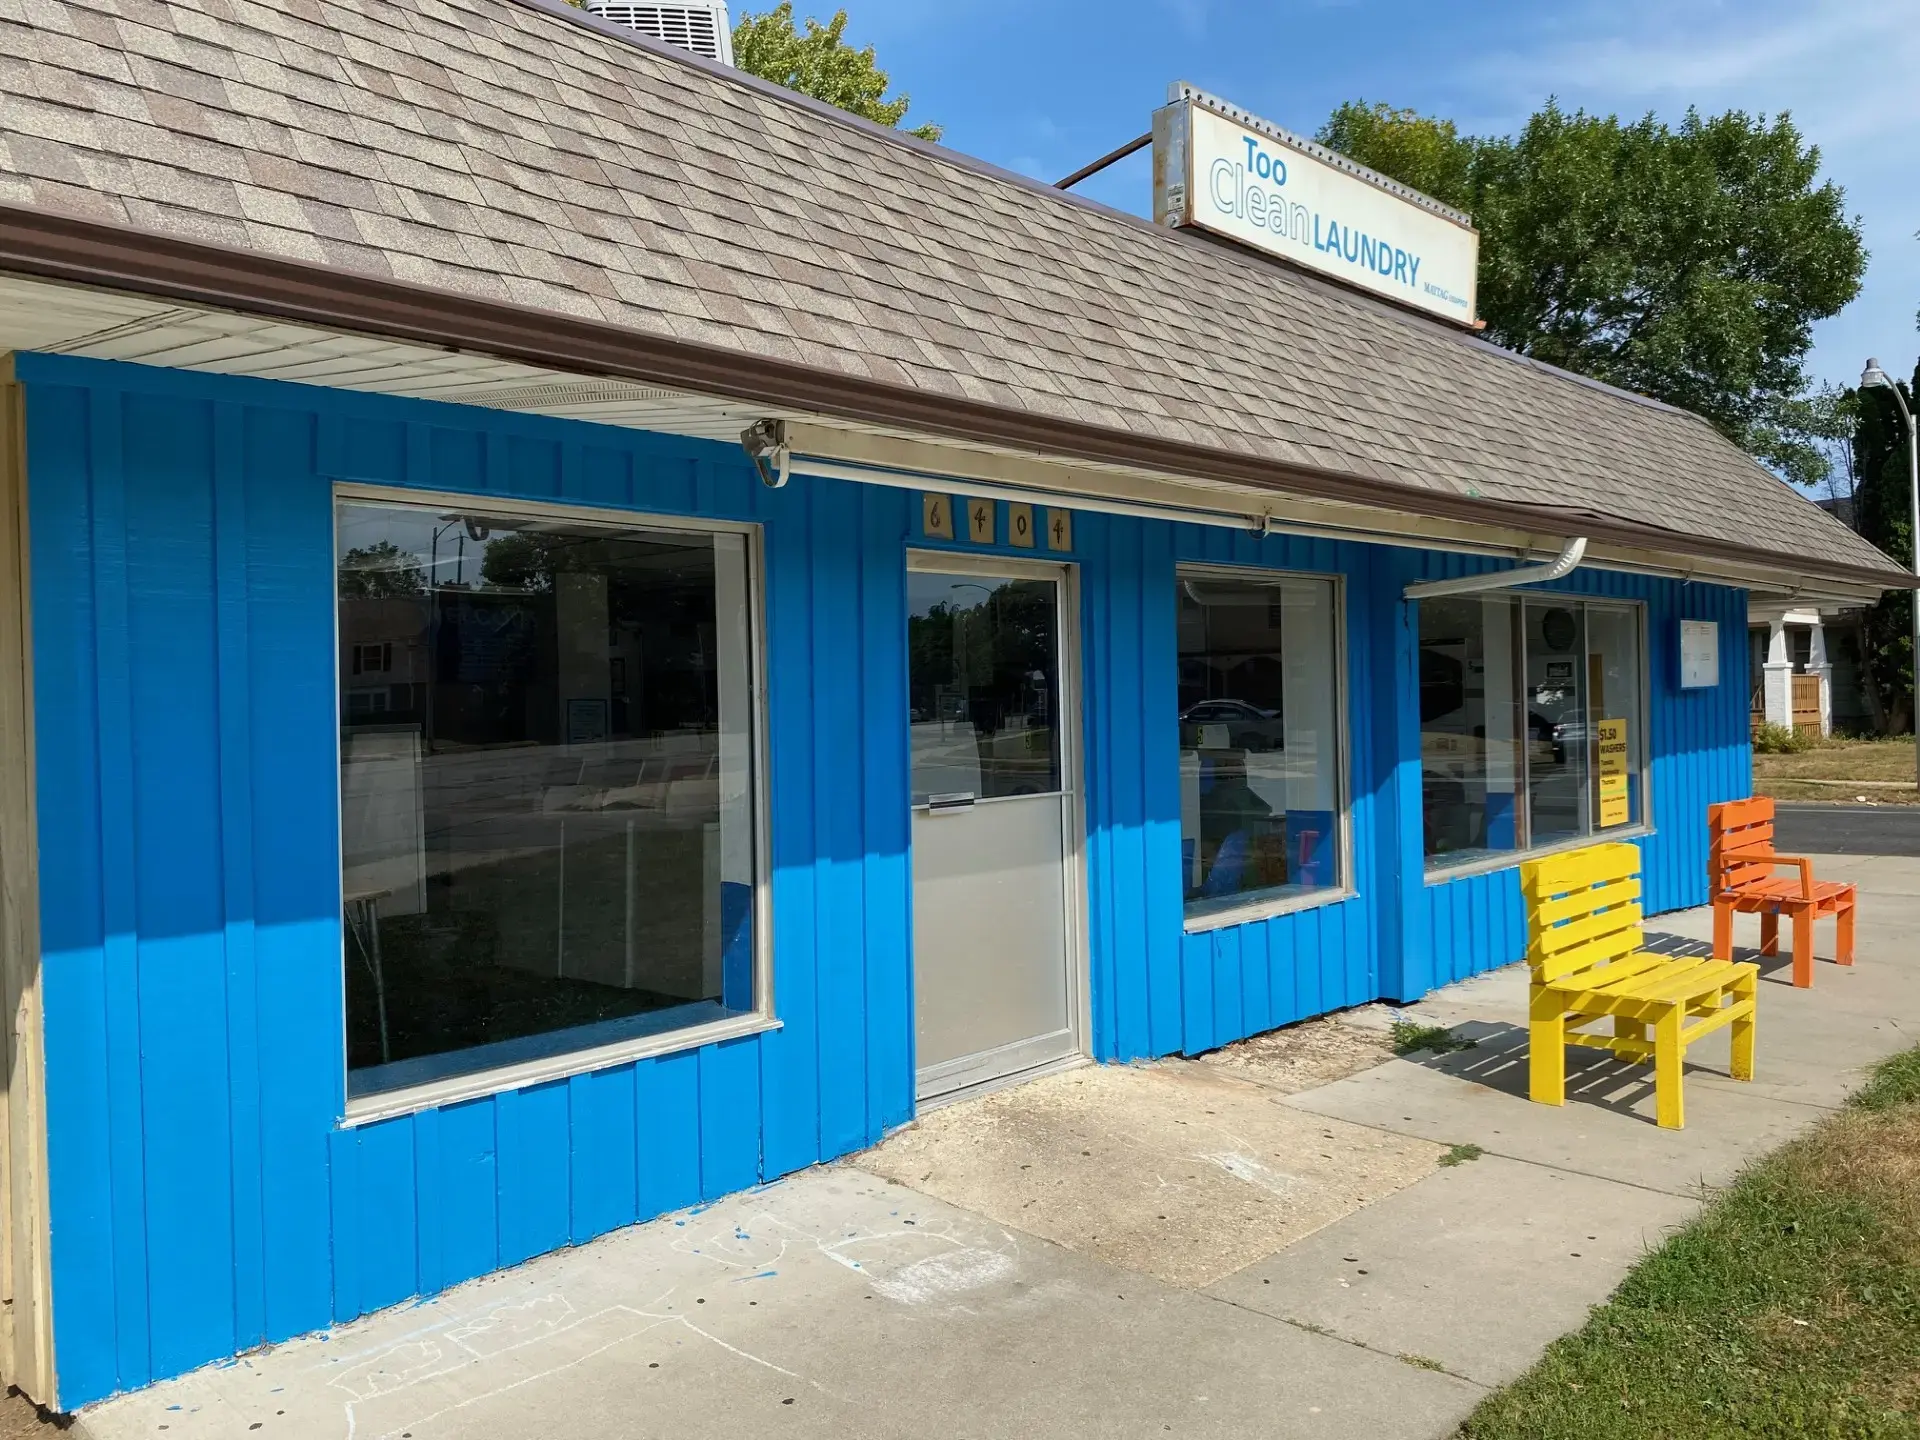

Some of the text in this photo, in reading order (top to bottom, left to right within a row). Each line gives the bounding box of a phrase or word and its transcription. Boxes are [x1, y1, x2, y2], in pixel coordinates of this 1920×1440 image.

[1243, 136, 1287, 186] Too
[1210, 158, 1421, 287] Clean LAUNDRY
[1600, 742, 1627, 755] WASHERS
